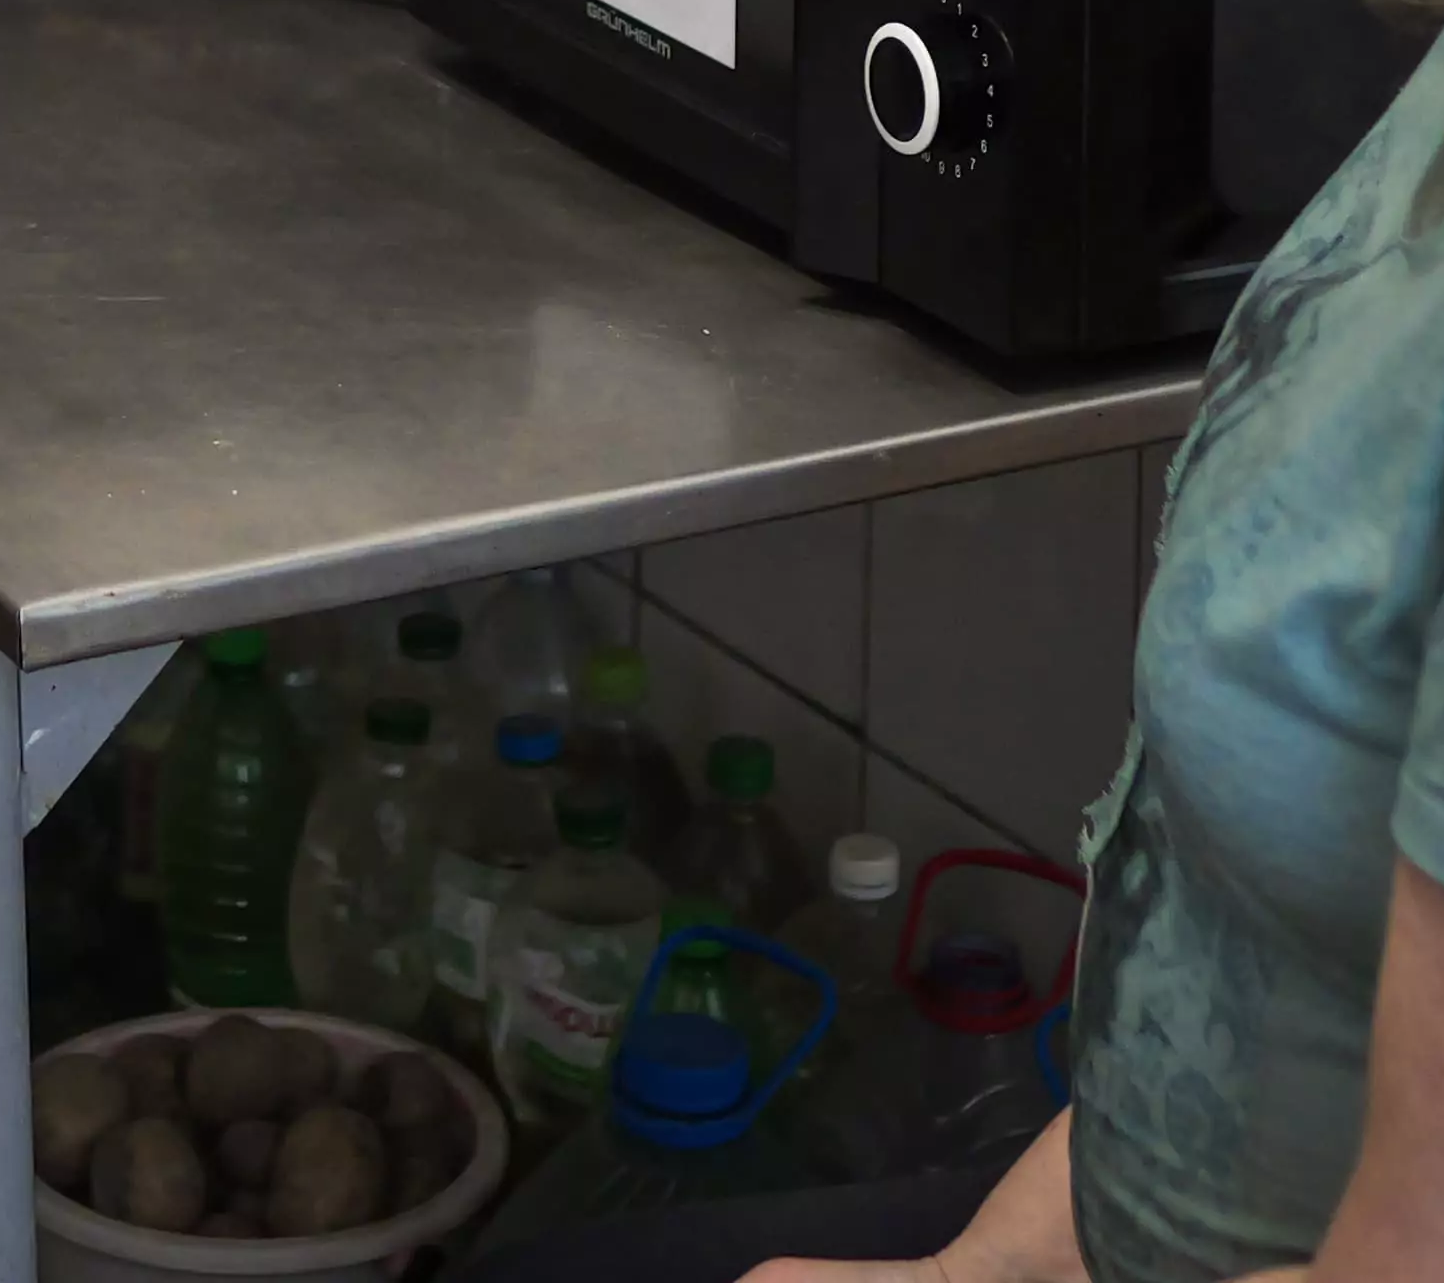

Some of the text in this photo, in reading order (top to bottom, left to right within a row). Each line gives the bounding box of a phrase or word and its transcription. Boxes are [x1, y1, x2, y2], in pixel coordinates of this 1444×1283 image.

[586, 1, 671, 59] GRÜNHELM
[972, 24, 978, 38] 2
[982, 53, 988, 67] 3
[987, 84, 993, 97] 4
[987, 114, 993, 128] 5
[981, 139, 987, 153] 6
[970, 157, 976, 170] 7
[955, 164, 961, 178] 8
